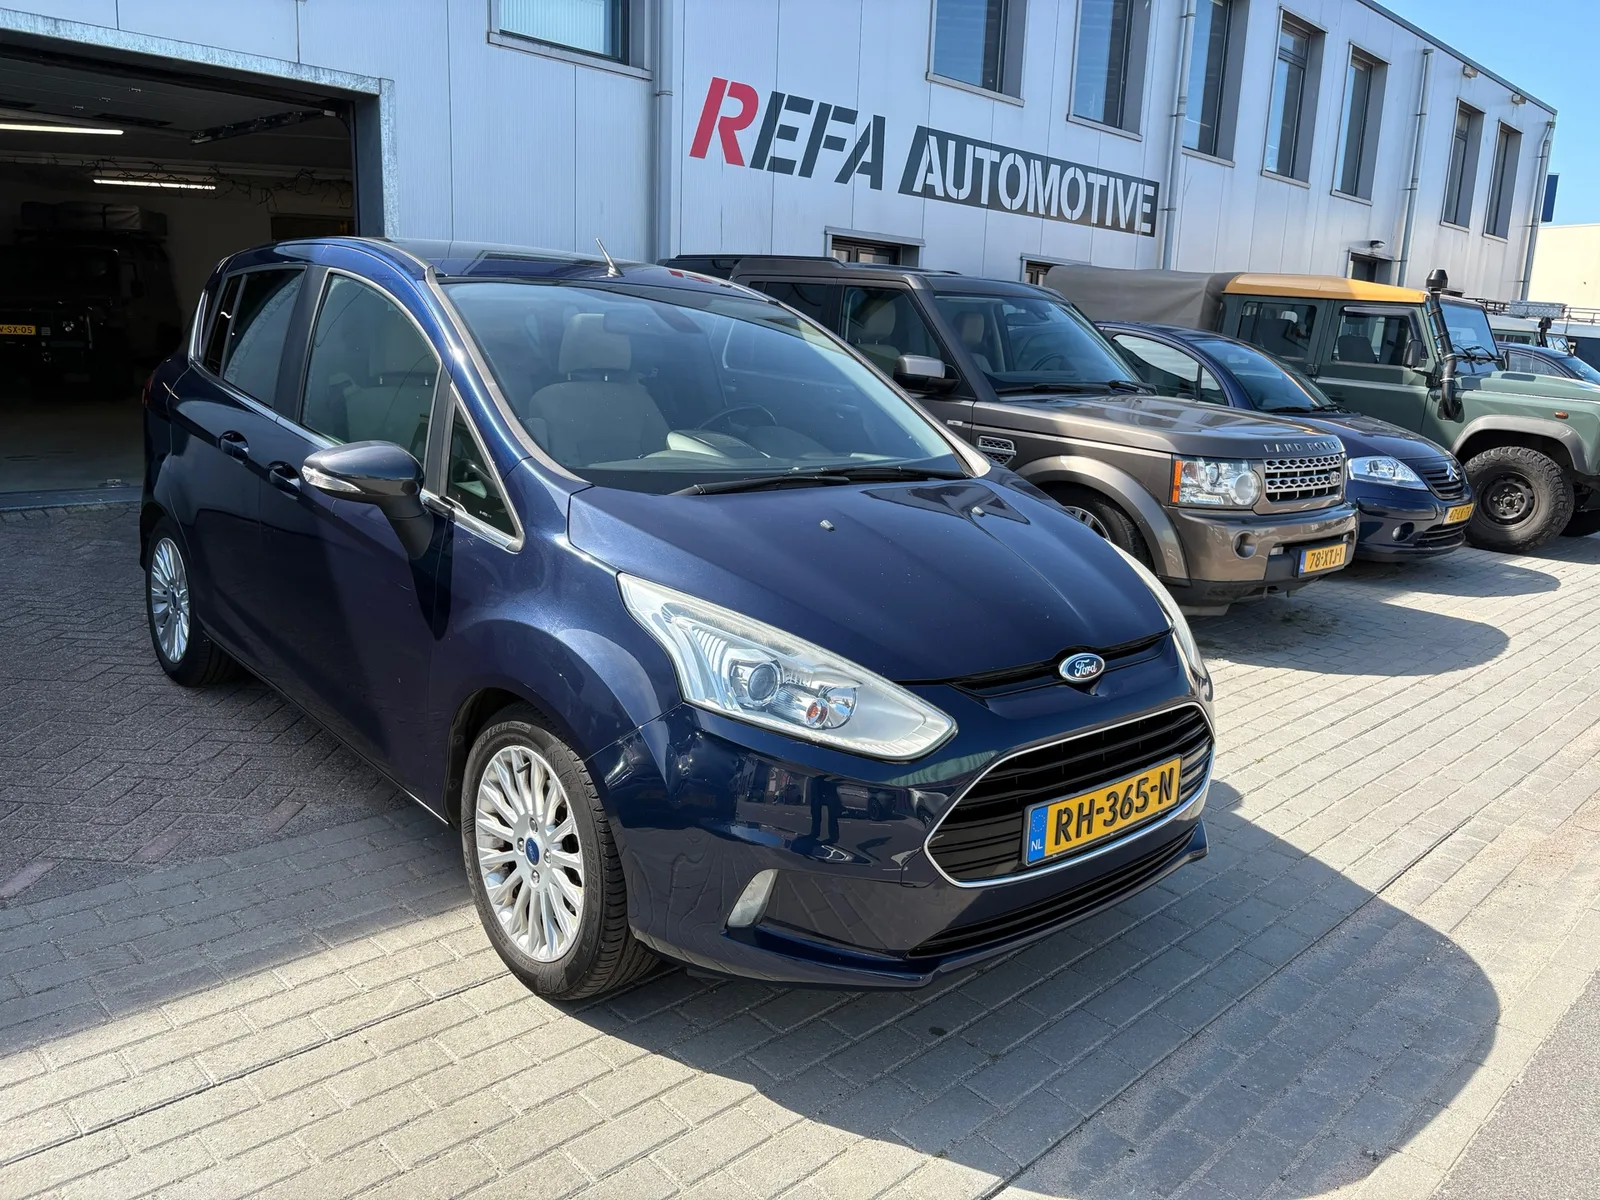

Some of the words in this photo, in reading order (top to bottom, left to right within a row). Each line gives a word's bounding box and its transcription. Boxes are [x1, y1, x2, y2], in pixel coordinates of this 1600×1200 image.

[690, 77, 885, 190] REFA
[912, 135, 1155, 233] AUTOMOTIVE
[1263, 443, 1303, 453] LAND
[1074, 659, 1097, 677] Ford
[1054, 767, 1175, 846] RH-365-N
[1030, 839, 1043, 851] NL
